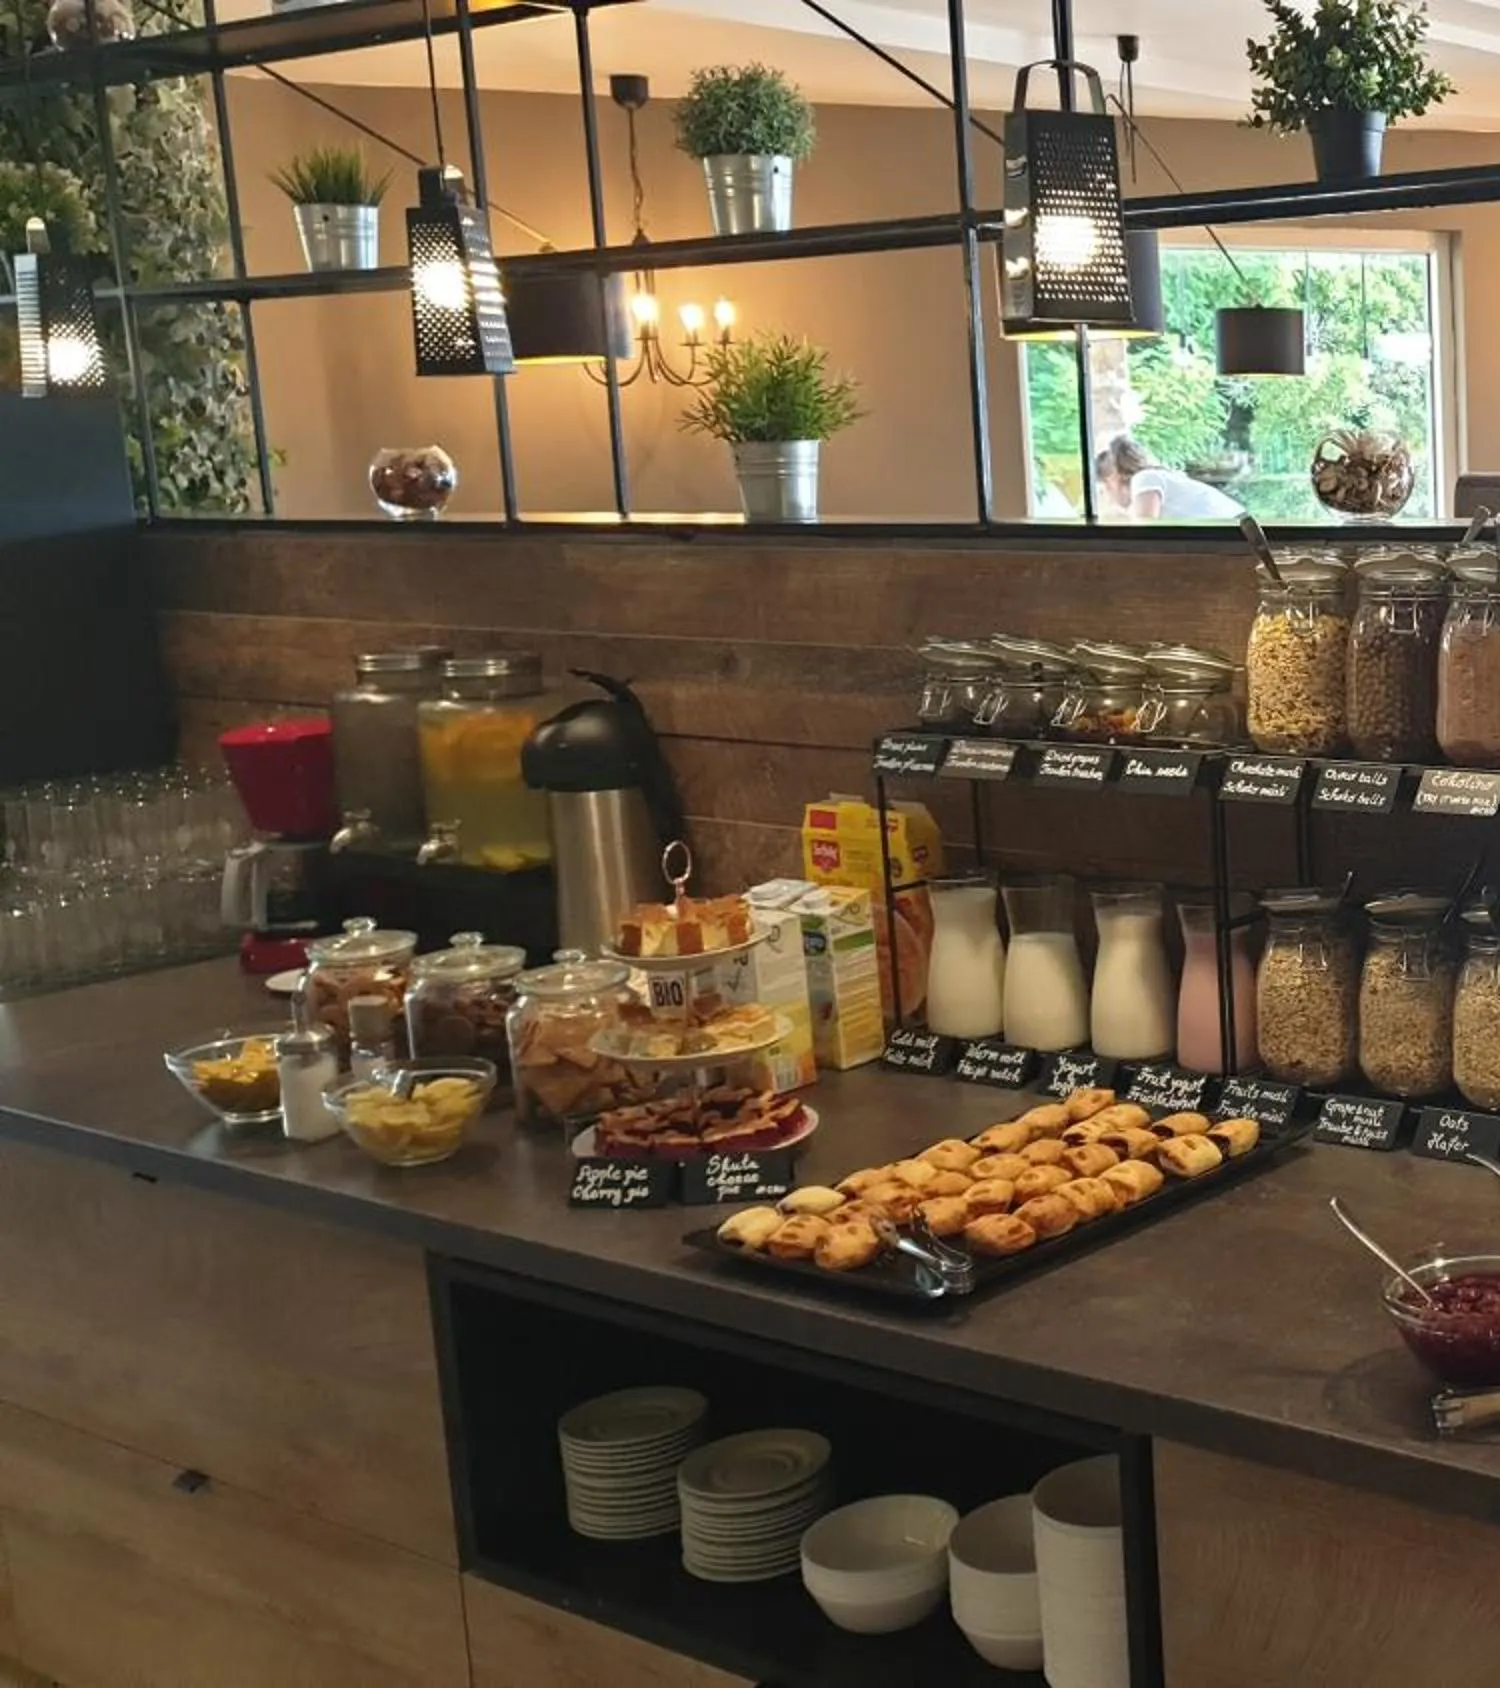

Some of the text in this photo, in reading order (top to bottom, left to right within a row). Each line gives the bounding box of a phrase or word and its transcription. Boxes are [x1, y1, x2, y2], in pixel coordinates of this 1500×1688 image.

[1048, 1075, 1096, 1097] Joght
[1439, 1115, 1470, 1133] Oats
[1427, 1132, 1470, 1156] Hafer
